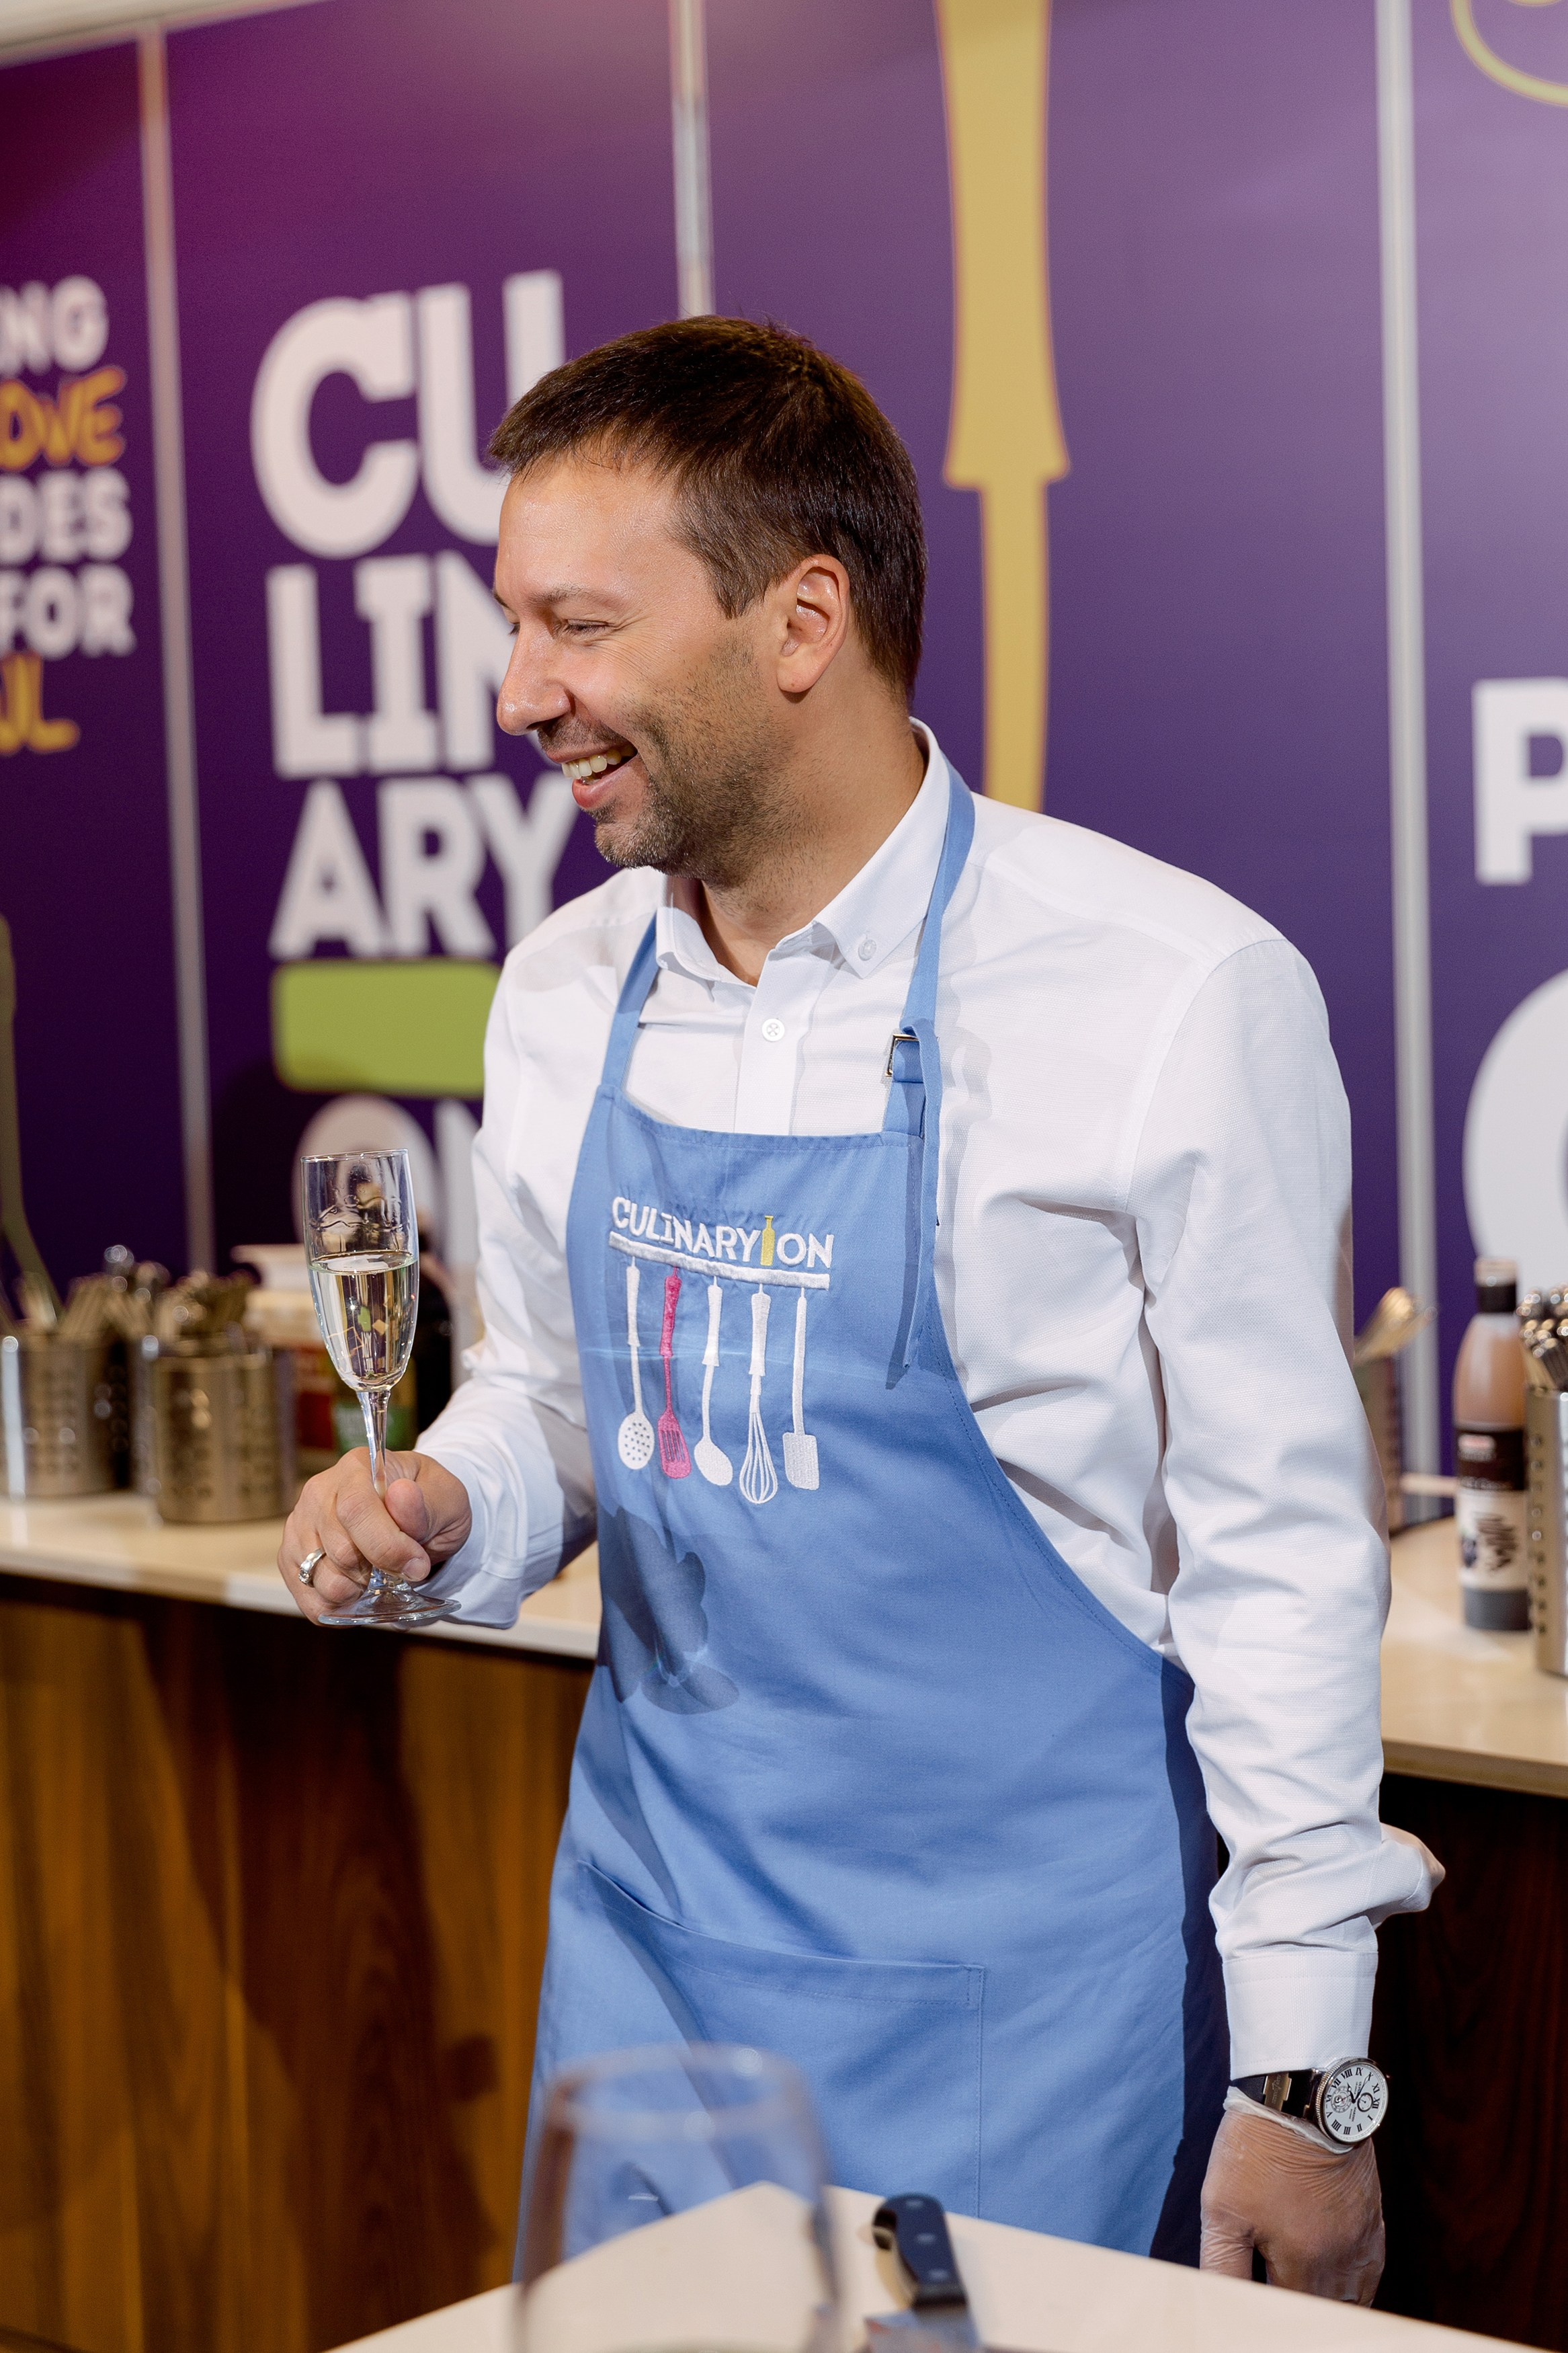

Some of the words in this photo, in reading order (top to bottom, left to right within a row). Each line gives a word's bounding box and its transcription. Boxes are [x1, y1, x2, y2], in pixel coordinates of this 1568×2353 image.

[269, 772, 581, 960] ARY
[612, 1196, 761, 1263] CULINARY
[776, 1232, 834, 1269] ON
